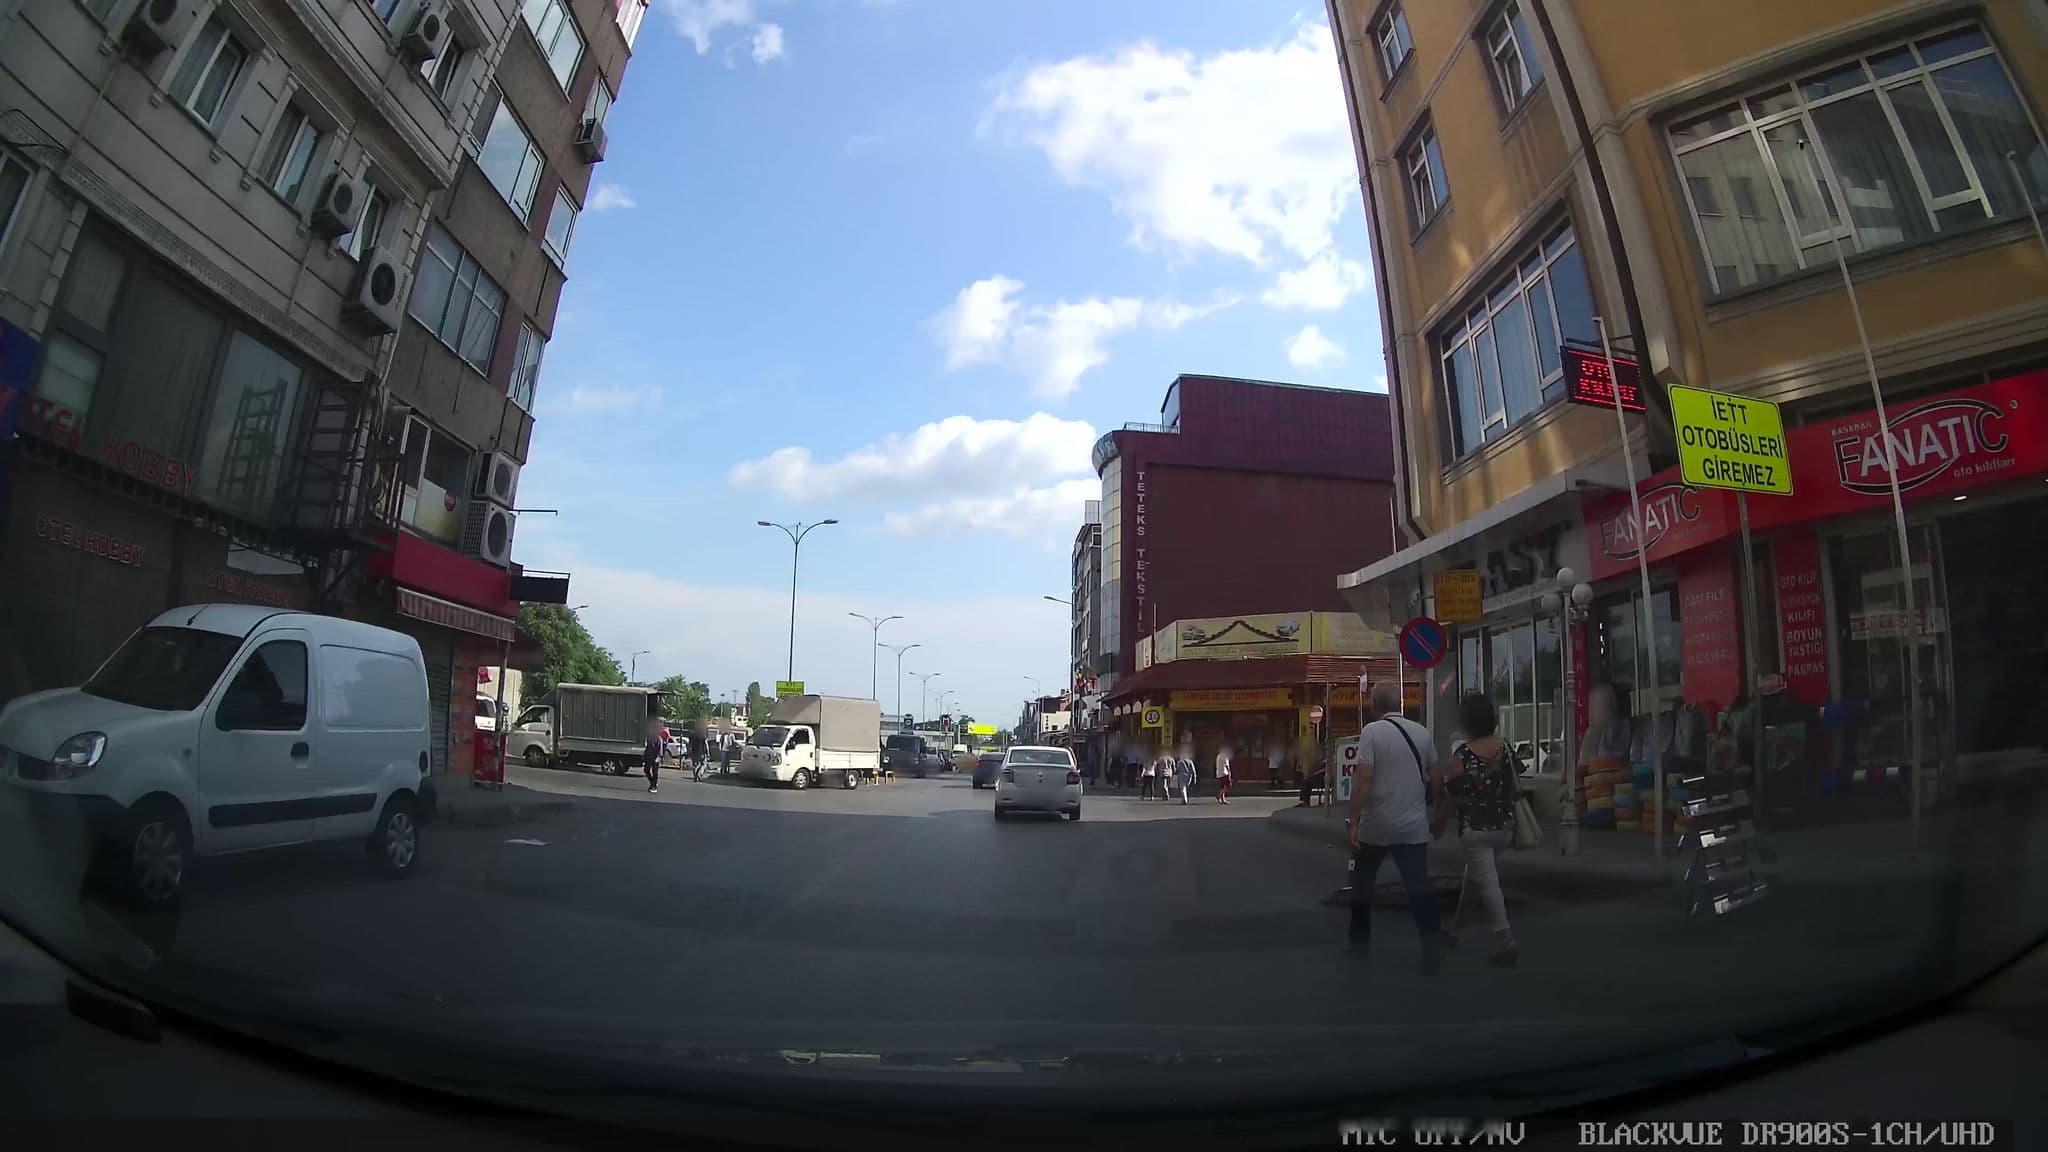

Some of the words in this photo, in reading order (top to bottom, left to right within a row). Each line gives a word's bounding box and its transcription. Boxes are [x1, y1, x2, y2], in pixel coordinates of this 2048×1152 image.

[1711, 395, 1747, 425] İETT
[1682, 425, 1784, 459] OTOBÜSLERİ
[1834, 406, 2009, 484] FANATIC
[103, 431, 199, 497] HOBBY
[1702, 456, 1777, 487] GİREMEZ
[1953, 463, 1973, 479] oto
[1136, 471, 1147, 536] TETEKS
[1600, 487, 1701, 556] FANATIC
[36, 514, 82, 549] OTEL
[85, 530, 146, 567] HOBBY
[1786, 626, 1822, 644] BOYUN
